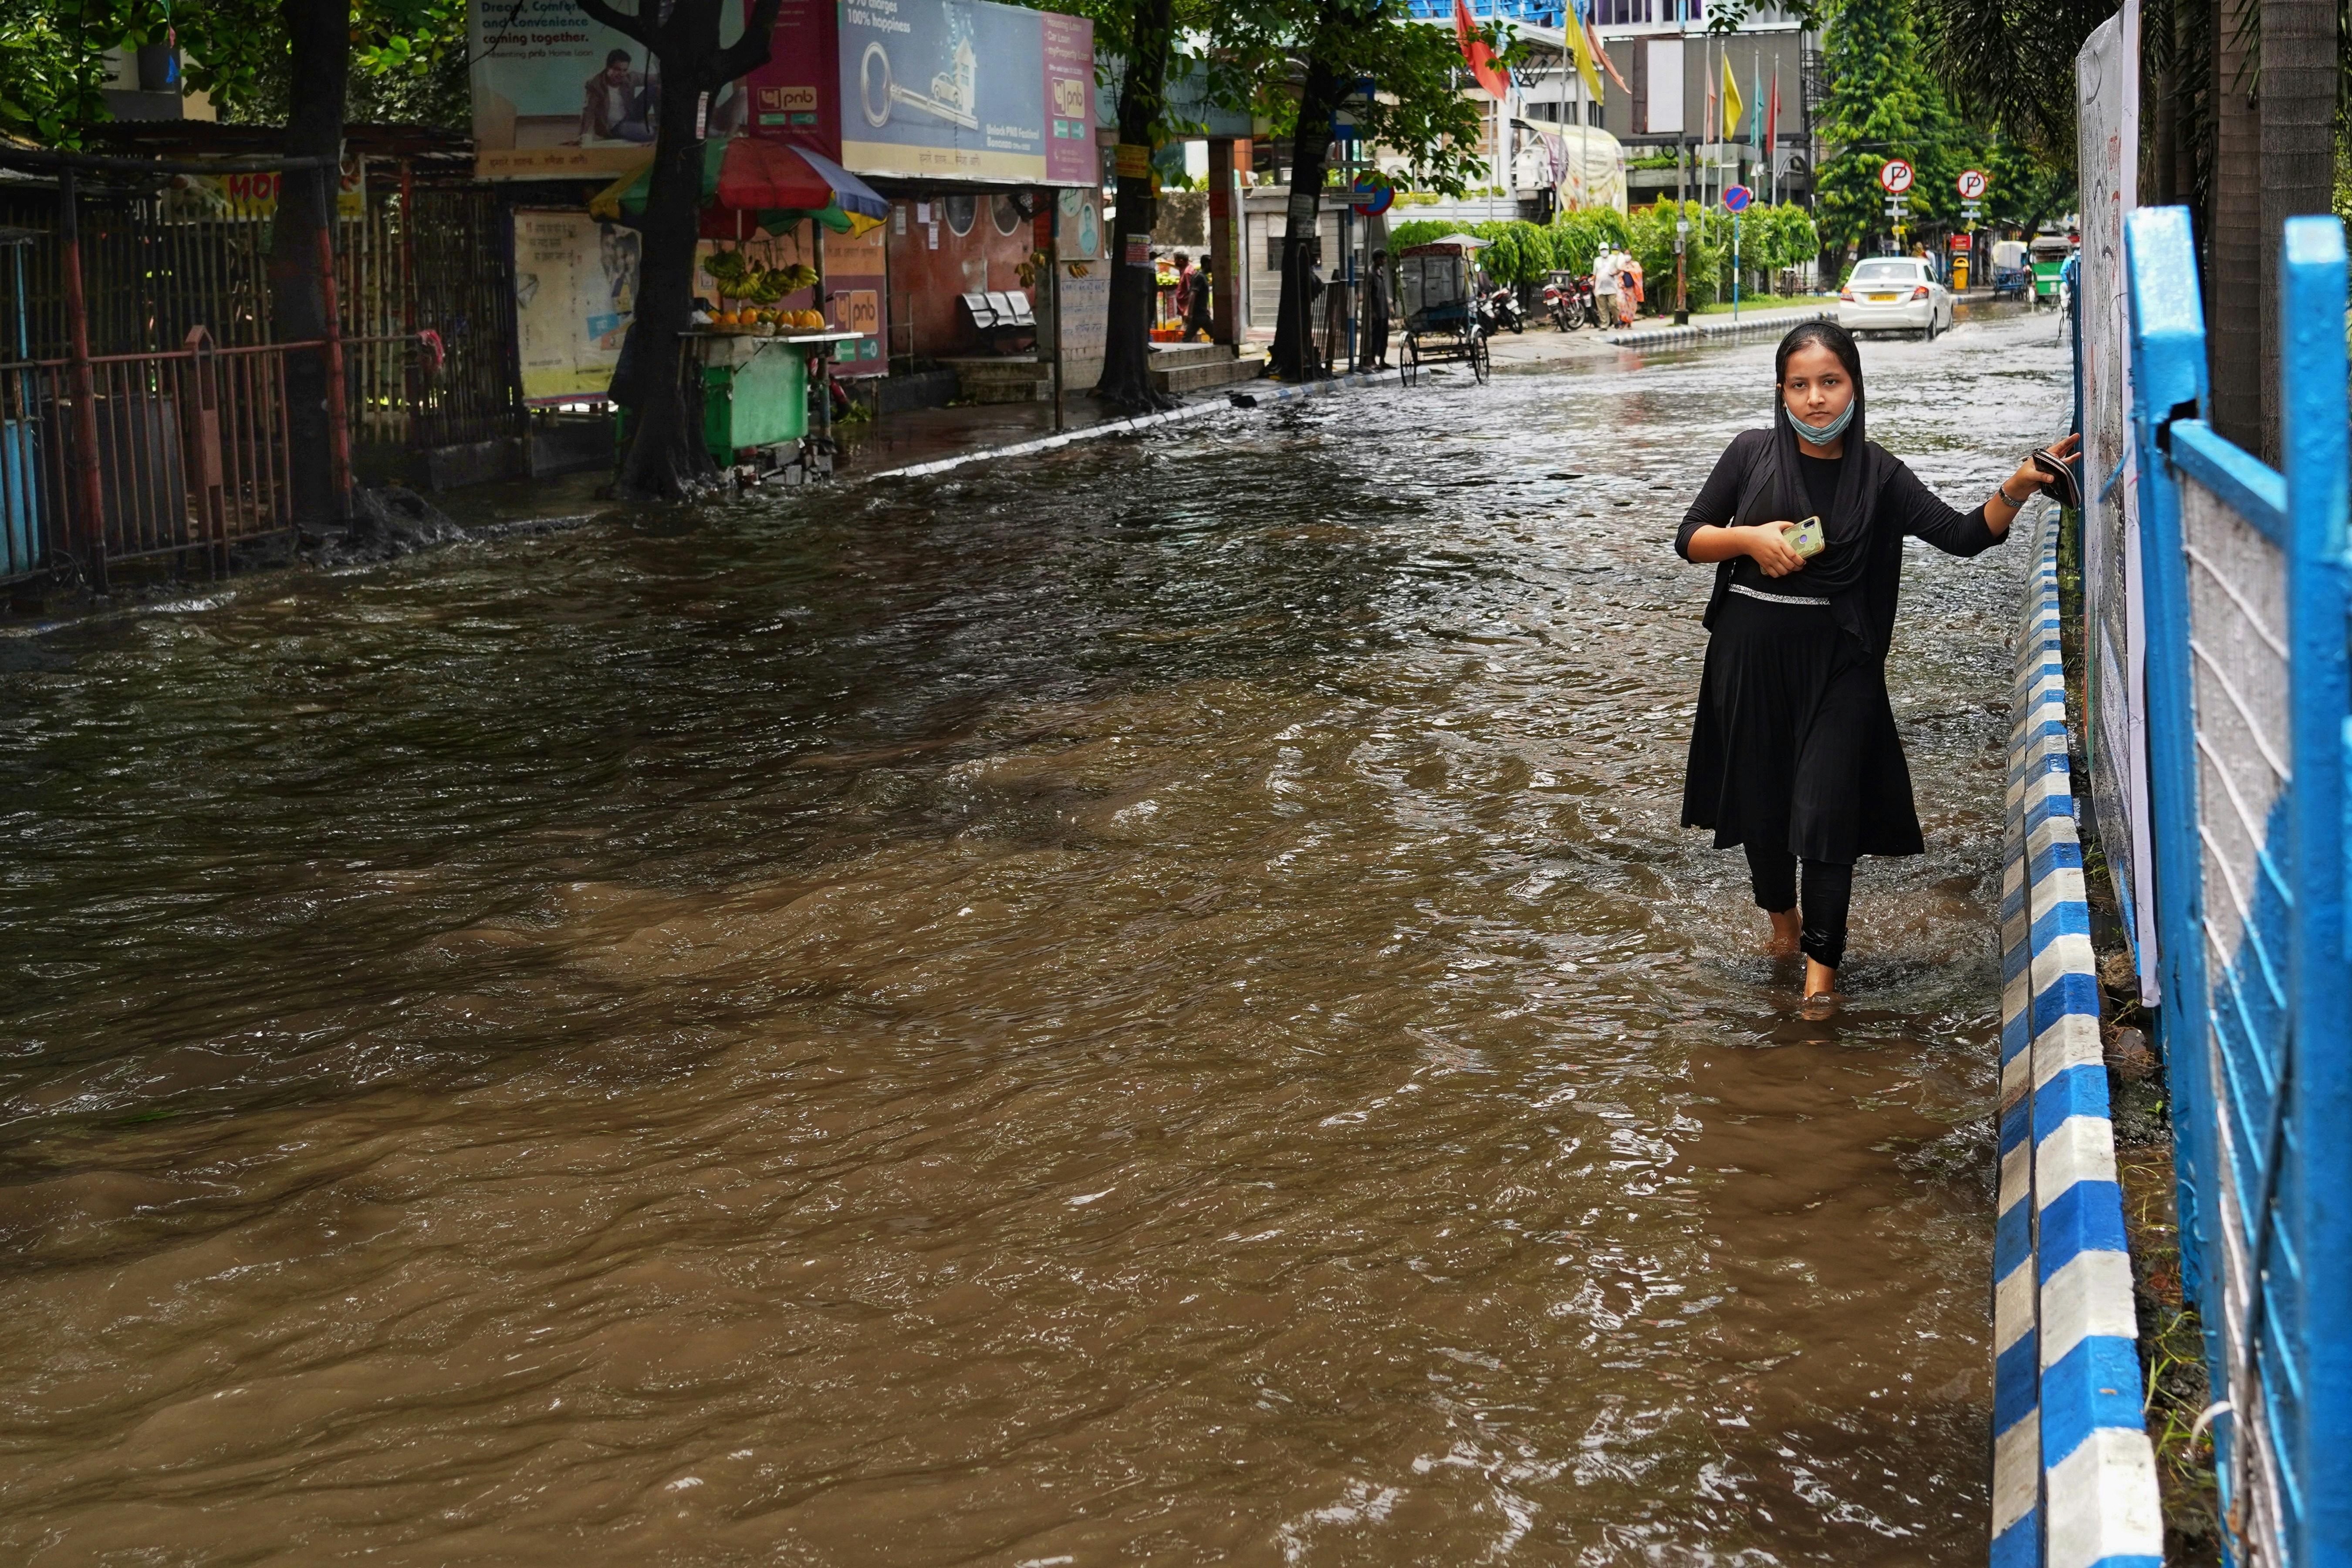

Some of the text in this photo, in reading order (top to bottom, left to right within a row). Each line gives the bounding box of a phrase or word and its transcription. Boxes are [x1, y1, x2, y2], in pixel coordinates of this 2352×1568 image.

[532, 1, 582, 12] Comfor
[511, 17, 588, 27] Convenience
[848, 9, 911, 33] 100% happiness
[483, 32, 588, 45] coming together.
[1058, 34, 1071, 43] Loan
[784, 90, 813, 107] pnb
[1067, 86, 1083, 112] pnb
[986, 124, 1005, 136] Unlock
[1892, 166, 1907, 186] P
[1967, 176, 1981, 194] P
[853, 296, 876, 330] pnb
